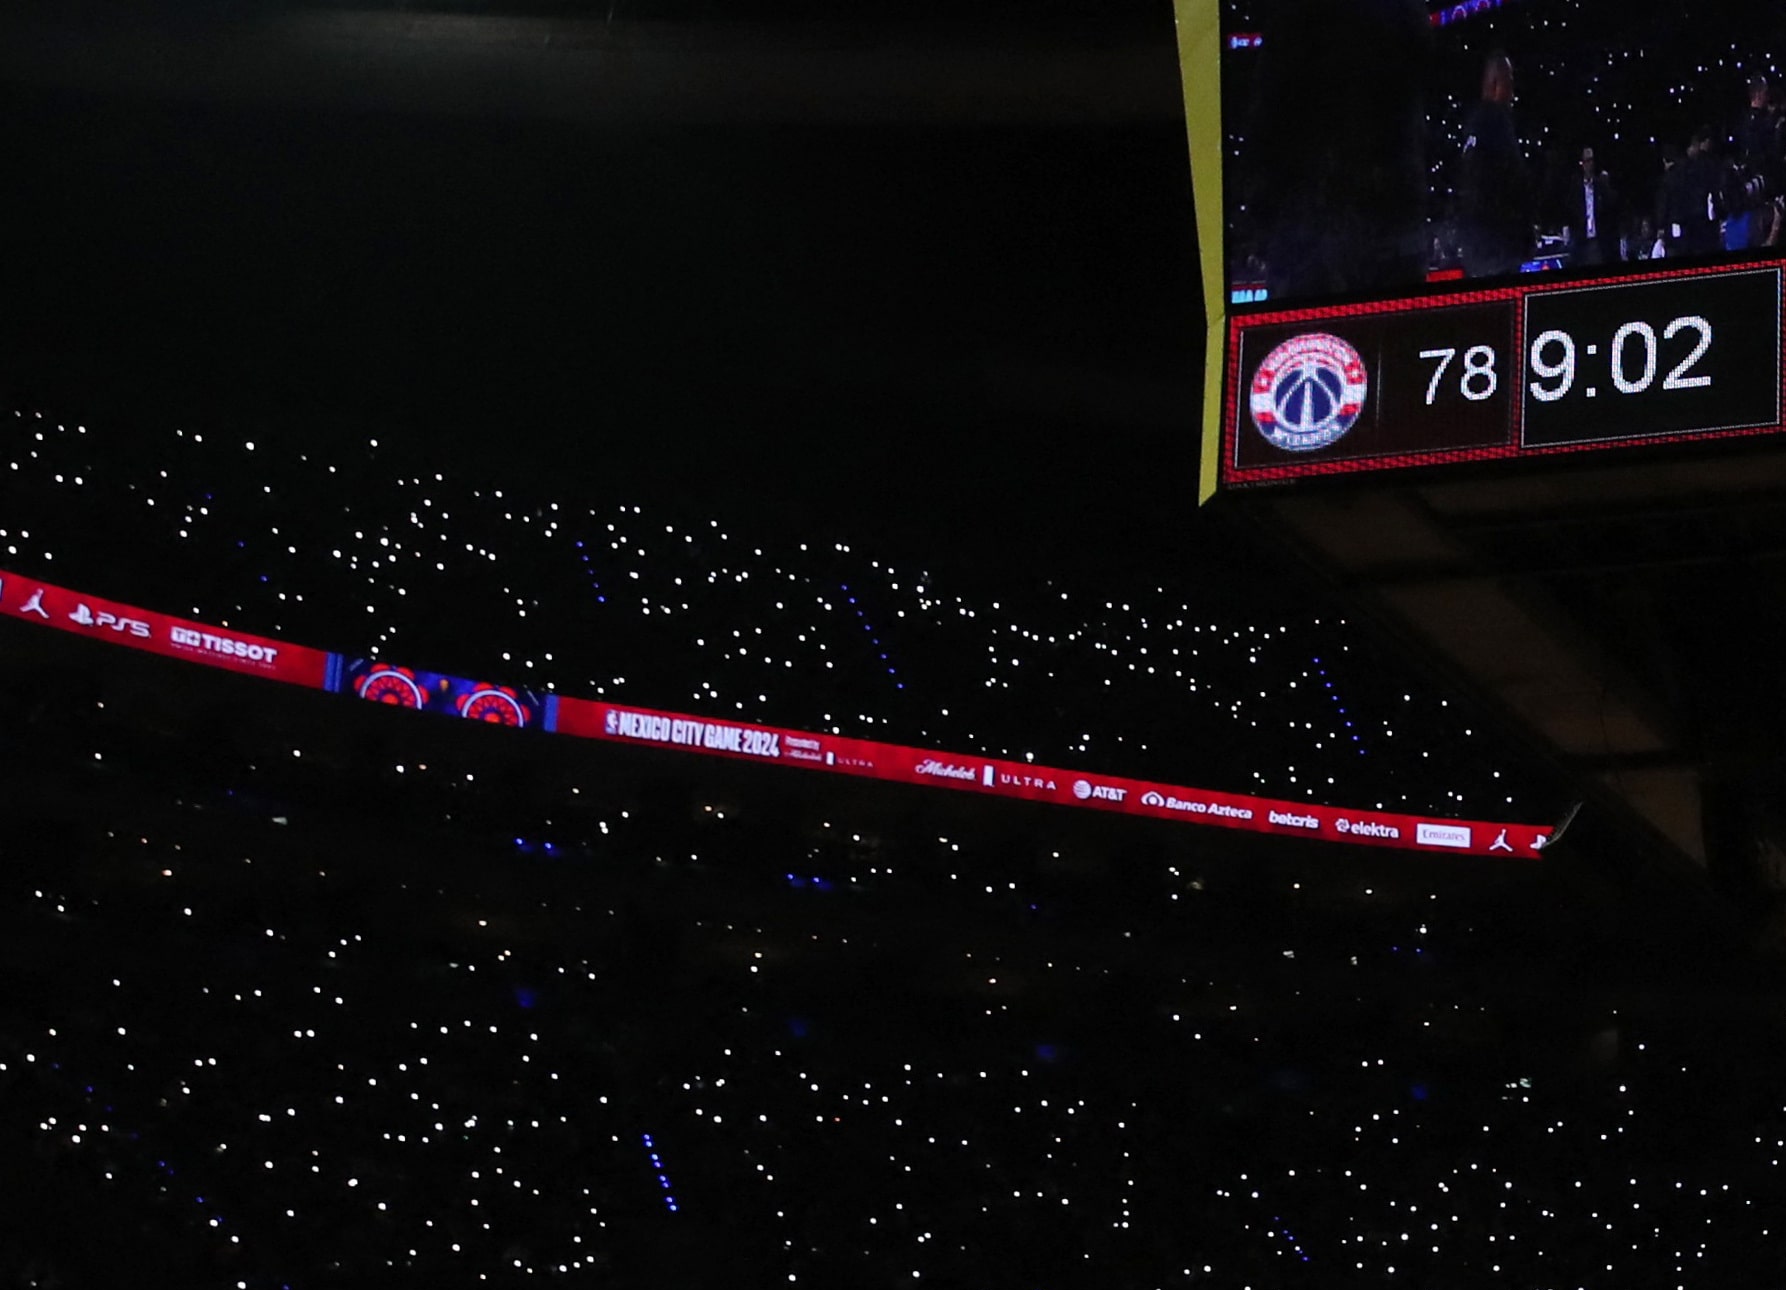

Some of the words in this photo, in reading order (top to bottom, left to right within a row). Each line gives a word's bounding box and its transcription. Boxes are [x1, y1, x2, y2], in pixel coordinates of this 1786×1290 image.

[1529, 315, 1712, 402] 9:02
[1419, 345, 1497, 405] 78
[97, 611, 151, 637] PS5
[201, 634, 277, 663] TISSOT
[619, 711, 670, 742] MEXICO
[672, 717, 704, 746] CITY
[704, 723, 742, 751] GAME
[742, 730, 780, 757] 2024
[1000, 774, 1056, 790] ULTRA
[1092, 786, 1127, 801] AT&T
[1166, 797, 1206, 813] Banco
[1208, 803, 1252, 819] Azteca
[1269, 811, 1318, 829] betcris
[1351, 822, 1399, 838] elektra
